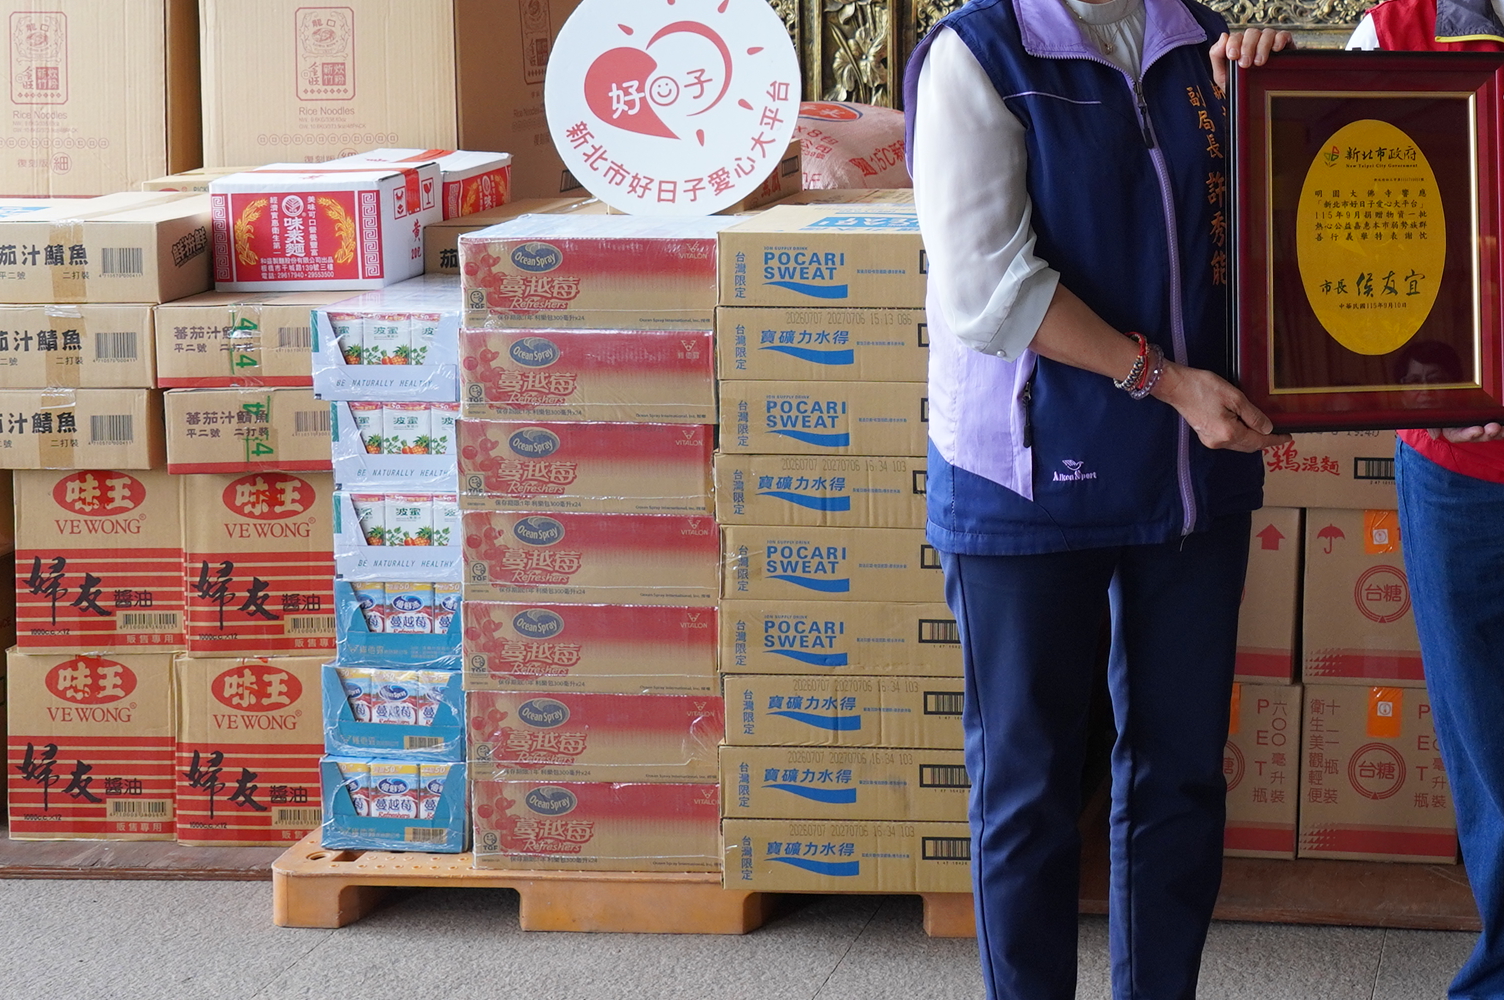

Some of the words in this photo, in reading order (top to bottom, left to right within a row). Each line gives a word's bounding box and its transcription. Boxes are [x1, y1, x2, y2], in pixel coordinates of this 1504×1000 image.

[13, 111, 31, 120] Rice
[34, 110, 68, 120] Noodles
[299, 106, 318, 116] Rice
[320, 106, 355, 116] Noodles
[1186, 85, 1225, 160] 副局長
[566, 79, 791, 204] 新北市好日子愛心大平台
[1345, 146, 1417, 162] 新北市政府
[283, 217, 306, 257] 味素麵
[514, 251, 536, 267] Ocean
[536, 252, 556, 268] Spray
[764, 252, 845, 266] POCARI
[735, 251, 747, 299] 台灣限定
[764, 267, 837, 280] SWEAT
[500, 275, 580, 299] 蔓越莓
[1319, 278, 1348, 295] 市長
[511, 297, 567, 309] Refreshers
[760, 330, 850, 345] 寶礦力水得
[766, 401, 846, 414] POCARI
[766, 415, 839, 428] SWEAT
[512, 438, 533, 452] Ocean
[534, 438, 553, 453] Spray
[498, 460, 577, 483] 蔓越莓
[507, 481, 565, 494] Refreshers
[757, 476, 846, 491] 寶礦力水得
[65, 473, 135, 512] 味王
[114, 590, 153, 608] 醬油
[1364, 583, 1402, 604] 台糖
[390, 615, 427, 629] 蔓越莓
[126, 634, 174, 644] 販售專用
[57, 662, 126, 700] 味王
[1307, 699, 1325, 805] 衛生美觀輕便
[1323, 699, 1341, 805] 十二瓶裝
[763, 768, 852, 783] 寶礦力水得
[1358, 760, 1397, 780] 台糖
[104, 777, 143, 796] 醬油
[529, 795, 550, 809] Ocean
[550, 796, 570, 810] Spray
[514, 818, 594, 843] 蔓越莓
[523, 840, 581, 853] Refreshers
